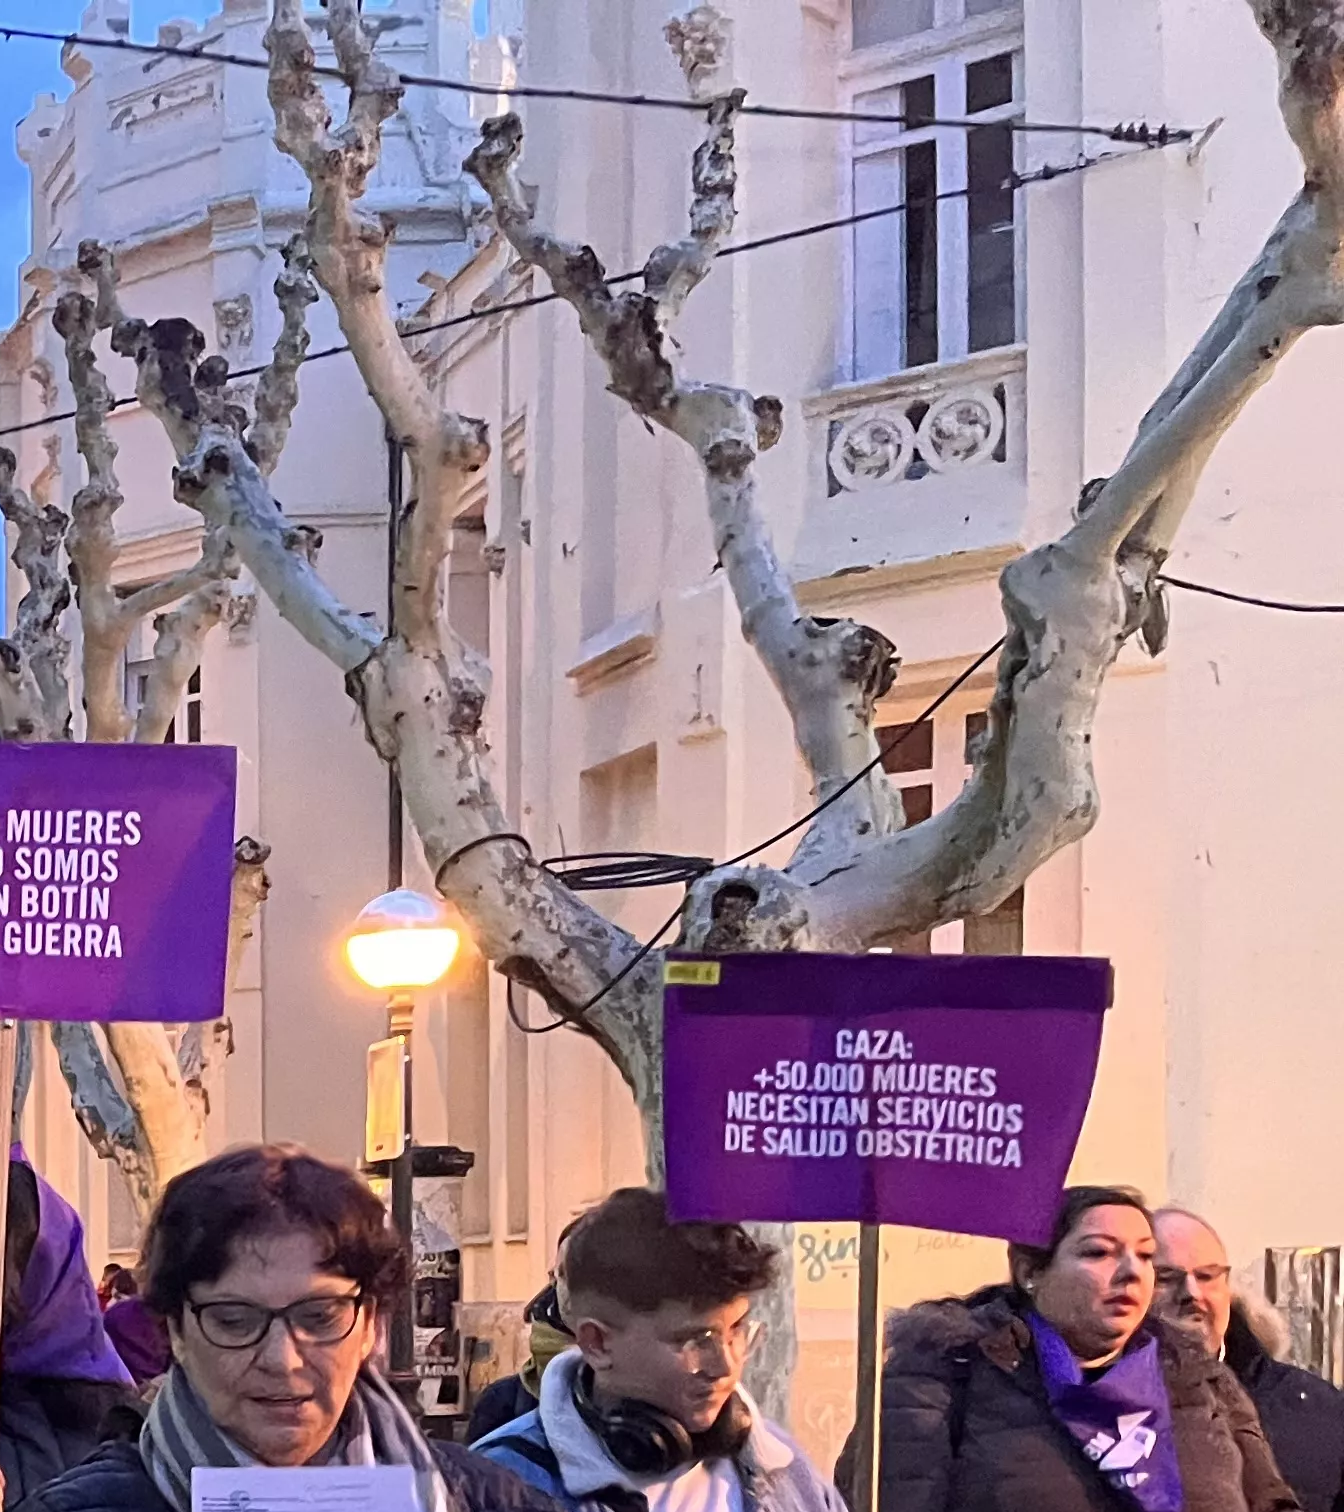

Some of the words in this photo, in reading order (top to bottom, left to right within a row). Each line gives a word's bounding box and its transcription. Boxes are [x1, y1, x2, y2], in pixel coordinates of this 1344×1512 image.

[6, 809, 142, 846] MUJERES
[14, 847, 119, 883] SOMOS
[20, 880, 111, 920] BOTÍN
[3, 922, 123, 958] GUERRA
[835, 1029, 914, 1061] GAZA:
[753, 1061, 865, 1094] +50.000
[872, 1065, 998, 1098] MUJERES
[727, 1092, 869, 1127] NECESITAN
[877, 1097, 1024, 1133] SERVICIOS
[724, 1123, 755, 1154] DE
[761, 1126, 848, 1158] SALUD
